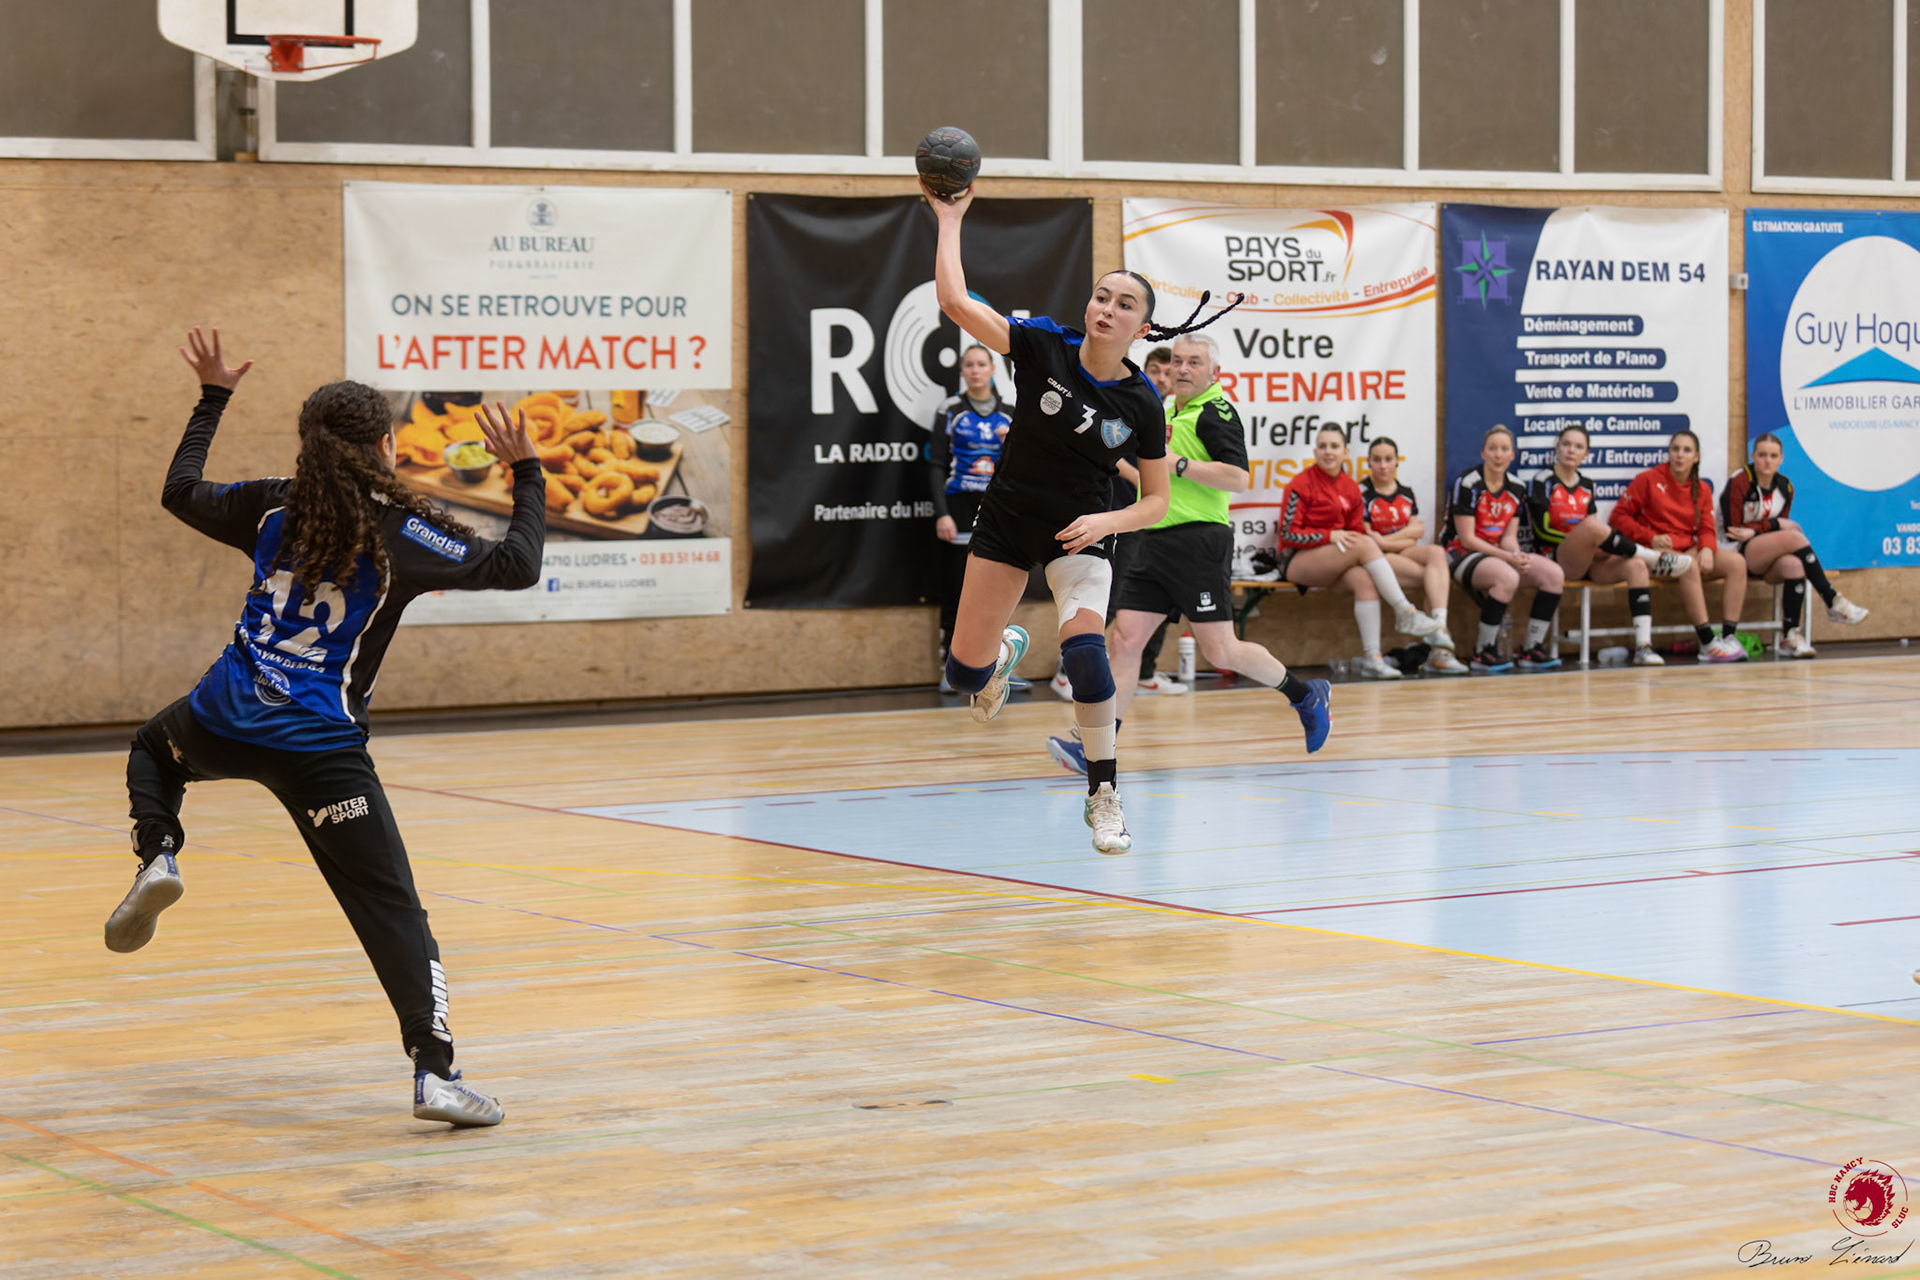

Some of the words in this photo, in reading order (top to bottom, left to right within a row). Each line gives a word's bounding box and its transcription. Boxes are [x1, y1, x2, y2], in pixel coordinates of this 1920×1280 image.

[1752, 220, 1802, 232] ESTIMATION
[1803, 222, 1844, 234] GRATUITE
[489, 236, 515, 252] AU
[520, 236, 597, 253] BUREAU
[1225, 236, 1300, 258] PAYS
[1306, 248, 1322, 259] du
[1536, 260, 1614, 281] RAYAN
[1621, 261, 1670, 282] DEM
[1679, 263, 1705, 282] 54
[1226, 291, 1259, 306] Cub
[1273, 288, 1349, 306] Collectivité
[1363, 266, 1428, 298] Entreprise
[391, 294, 433, 316] ON
[441, 294, 470, 316] SE
[479, 295, 612, 317] RETROUVE
[621, 296, 687, 317] POUR
[1523, 316, 1634, 335] Déménagement
[1795, 312, 1847, 352] Guy
[1856, 312, 1920, 352] Hoqu
[378, 335, 526, 370] L'AFTER
[538, 335, 676, 370] MATCH
[688, 335, 706, 370] ?
[1233, 329, 1333, 358] Votre
[1524, 351, 1591, 368] Transport
[1594, 350, 1612, 366] de
[1616, 351, 1657, 366] Piano
[1047, 377, 1069, 395] CRAFT
[1219, 370, 1406, 402] RTENAIRE
[1525, 384, 1562, 399] Vente
[1566, 383, 1584, 398] de
[1586, 383, 1654, 399] Matériels
[1794, 396, 1887, 411] L'IMMOBILIER
[1892, 395, 1920, 410] GAR
[1073, 404, 1097, 434] 3
[1585, 417, 1604, 431] de
[1607, 417, 1661, 431] Camion
[1251, 414, 1370, 446] l'effrt
[814, 444, 845, 464] LA
[849, 442, 919, 462] RADIO
[1605, 450, 1669, 467] Entrepris
[814, 502, 888, 521] Partenaire
[890, 501, 911, 518] du
[913, 501, 936, 518] HB
[1242, 520, 1266, 535] 83
[1882, 536, 1902, 555] 03
[543, 554, 571, 567] 4710
[575, 553, 627, 568] LUDRES
[639, 553, 656, 565] 03
[660, 552, 674, 565] 83
[677, 552, 688, 564] 51
[692, 551, 703, 563] 14
[706, 551, 720, 563] 68
[577, 580, 616, 589] BUREAU
[619, 578, 657, 589] LUDRES
[253, 569, 346, 664] 12
[327, 796, 368, 815] INTER
[331, 805, 369, 824] SPORT
